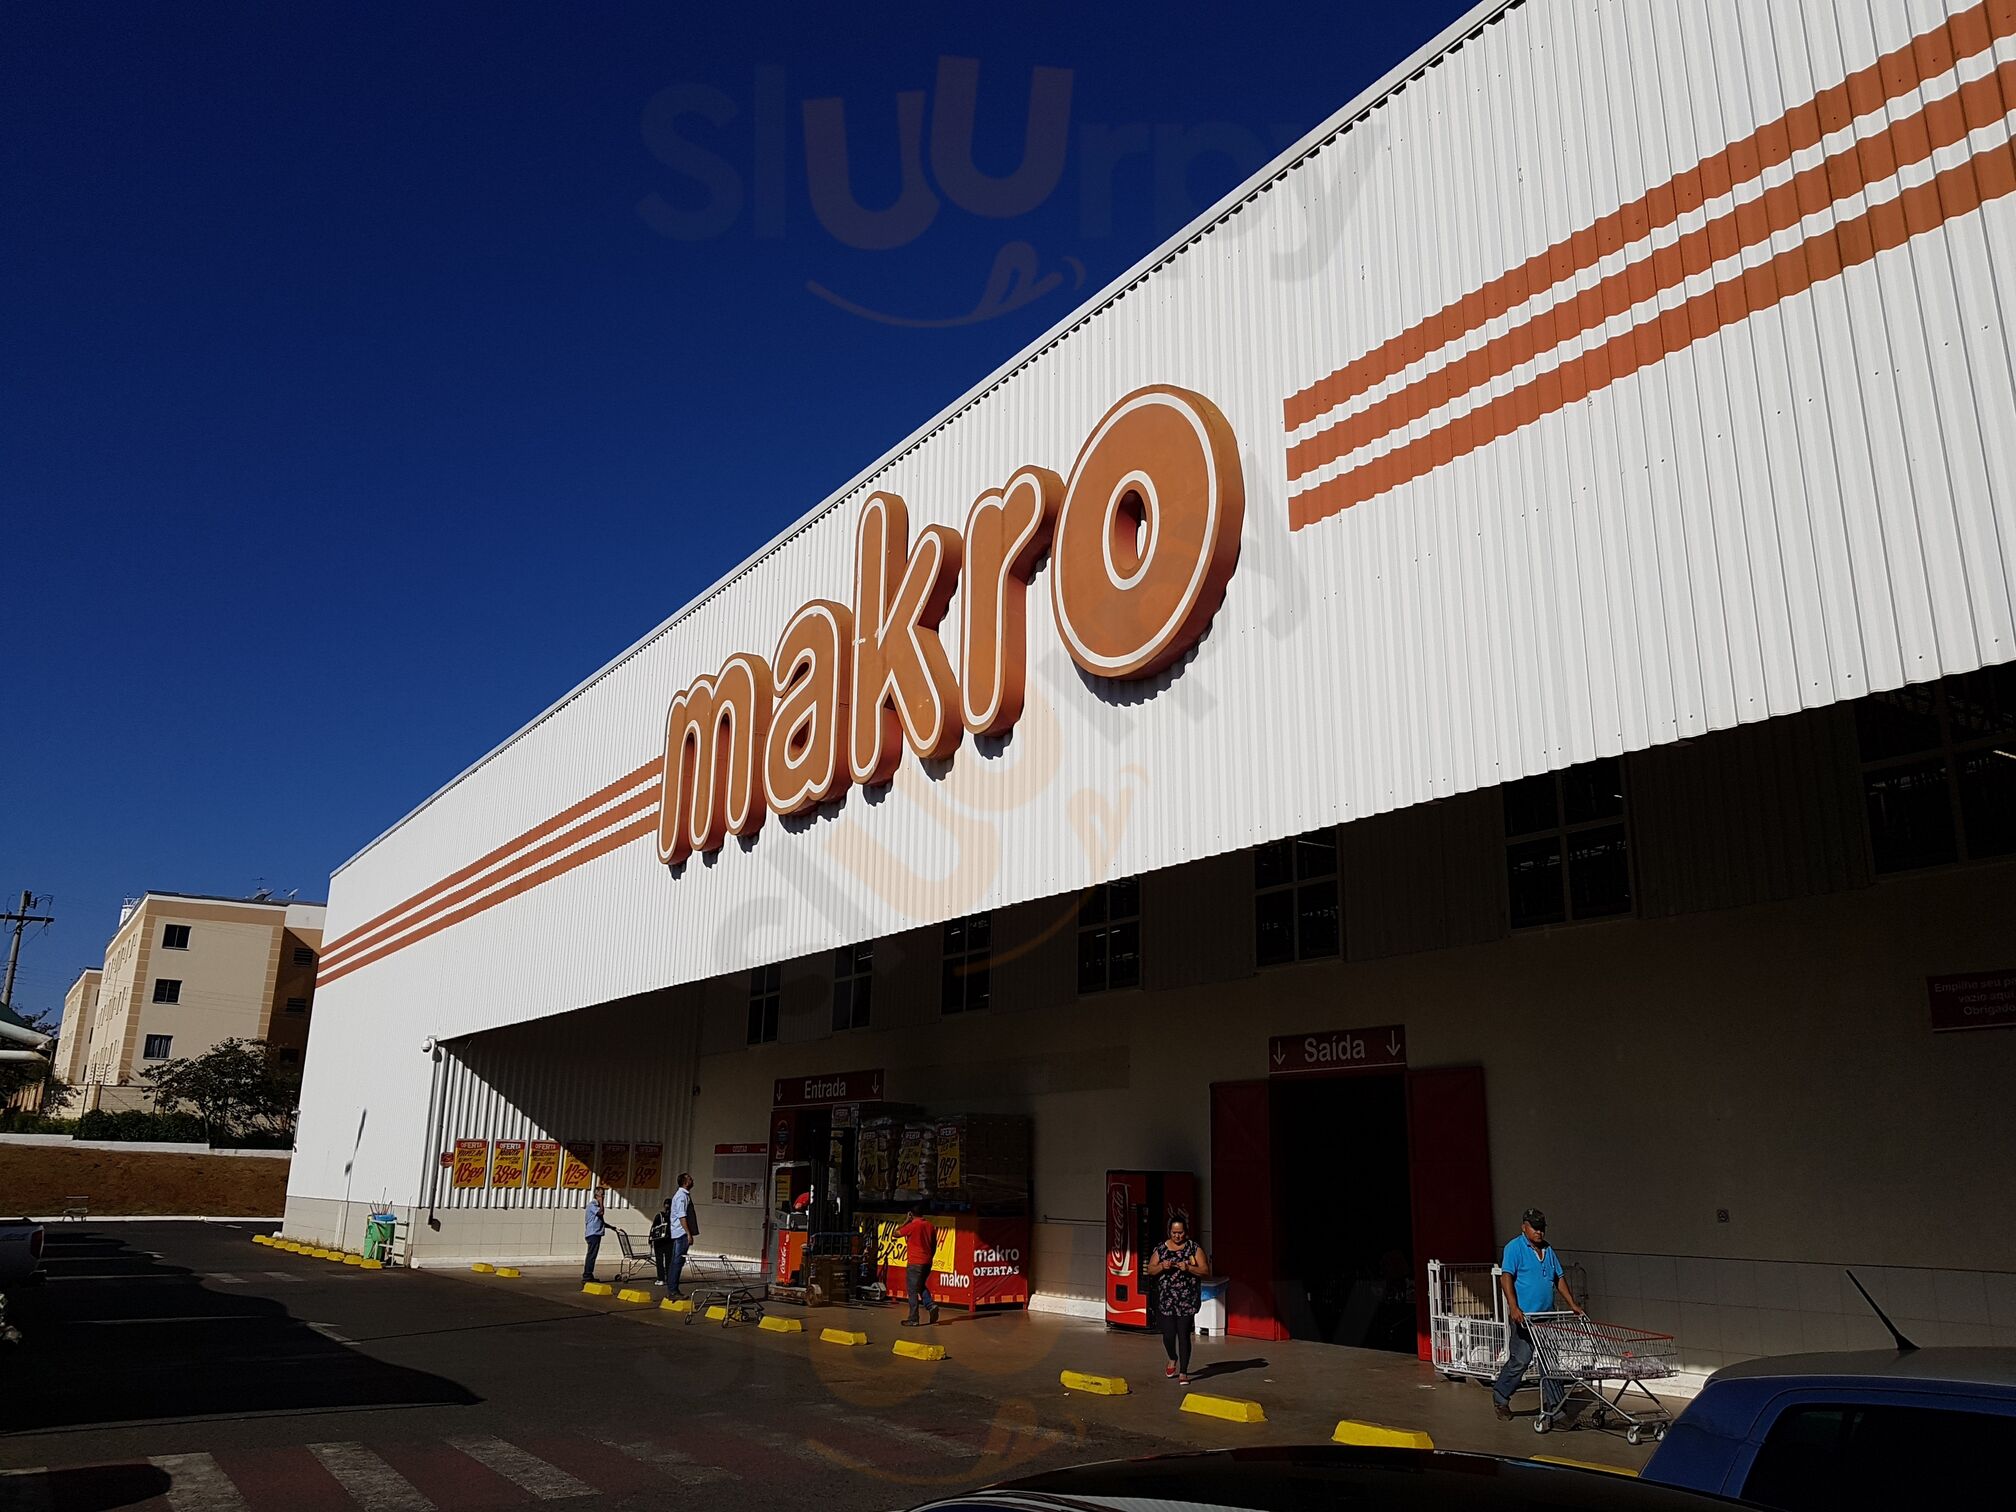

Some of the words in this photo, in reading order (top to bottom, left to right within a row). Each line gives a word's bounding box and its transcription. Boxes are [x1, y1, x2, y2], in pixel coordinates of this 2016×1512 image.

[657, 384, 1245, 865] makro
[1304, 1034, 1365, 1063] Saída
[804, 1077, 847, 1099] Entrada
[973, 1245, 1020, 1263] makro
[940, 1270, 970, 1288] makro
[973, 1265, 1020, 1277] OFERTAS
